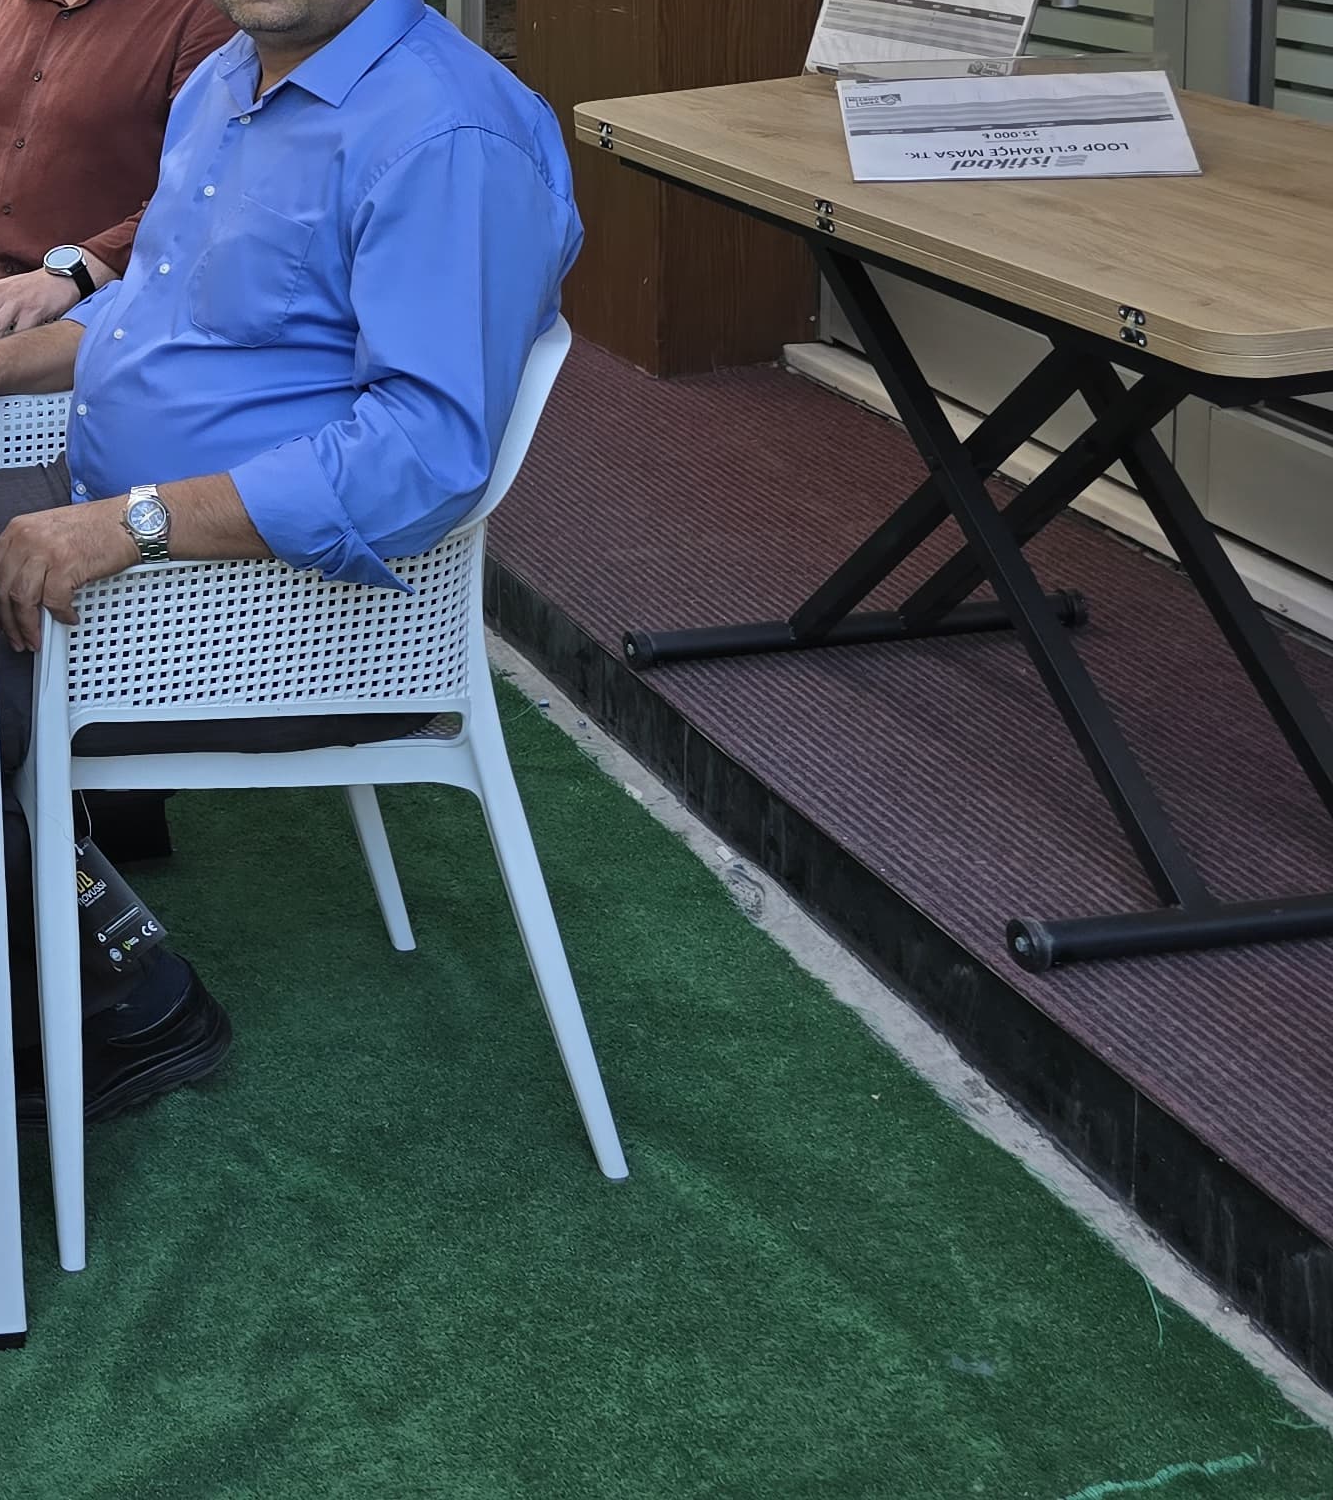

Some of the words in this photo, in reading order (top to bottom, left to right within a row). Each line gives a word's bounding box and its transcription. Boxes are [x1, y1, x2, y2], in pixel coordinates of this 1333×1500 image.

[994, 130, 1039, 138] 15.000
[987, 146, 1045, 157] BAHÇE
[1083, 141, 1129, 152] LOOP
[934, 149, 984, 158] MASA
[951, 155, 1051, 171] istikbal
